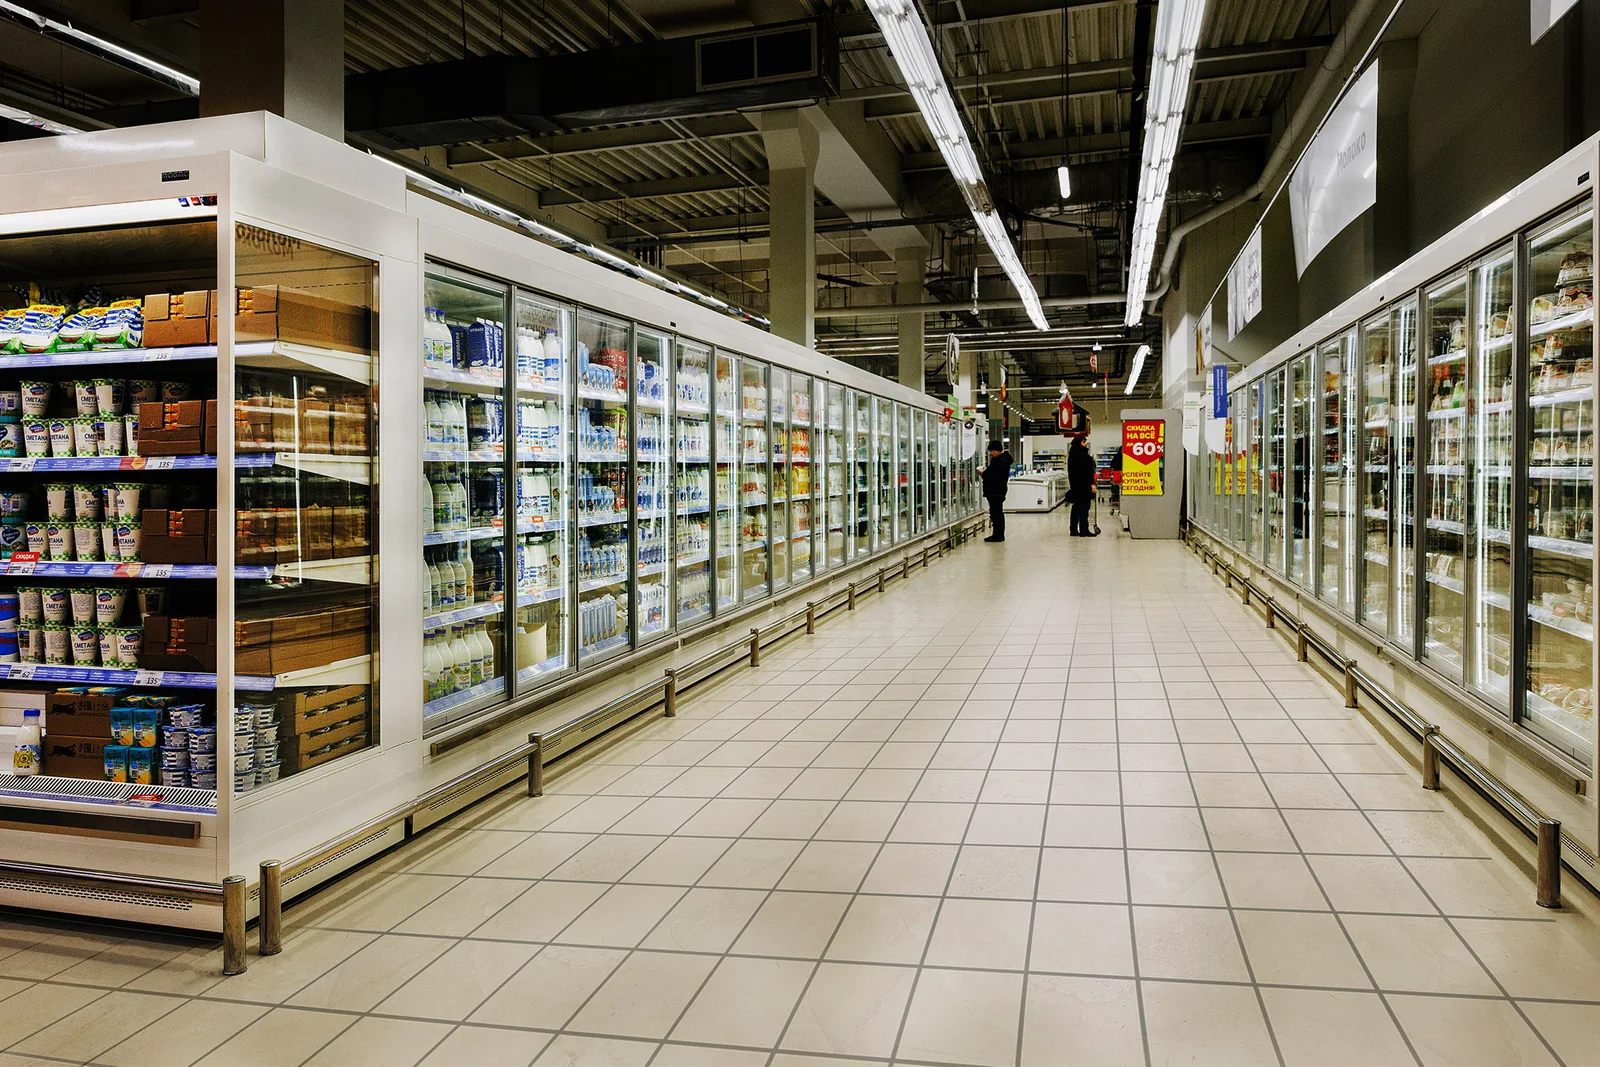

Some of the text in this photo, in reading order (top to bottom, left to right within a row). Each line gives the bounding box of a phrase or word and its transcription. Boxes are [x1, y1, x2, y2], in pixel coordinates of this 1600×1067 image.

[1140, 431, 1155, 439] ВСЁ
[155, 569, 167, 577] 135
[146, 677, 158, 685] 135
